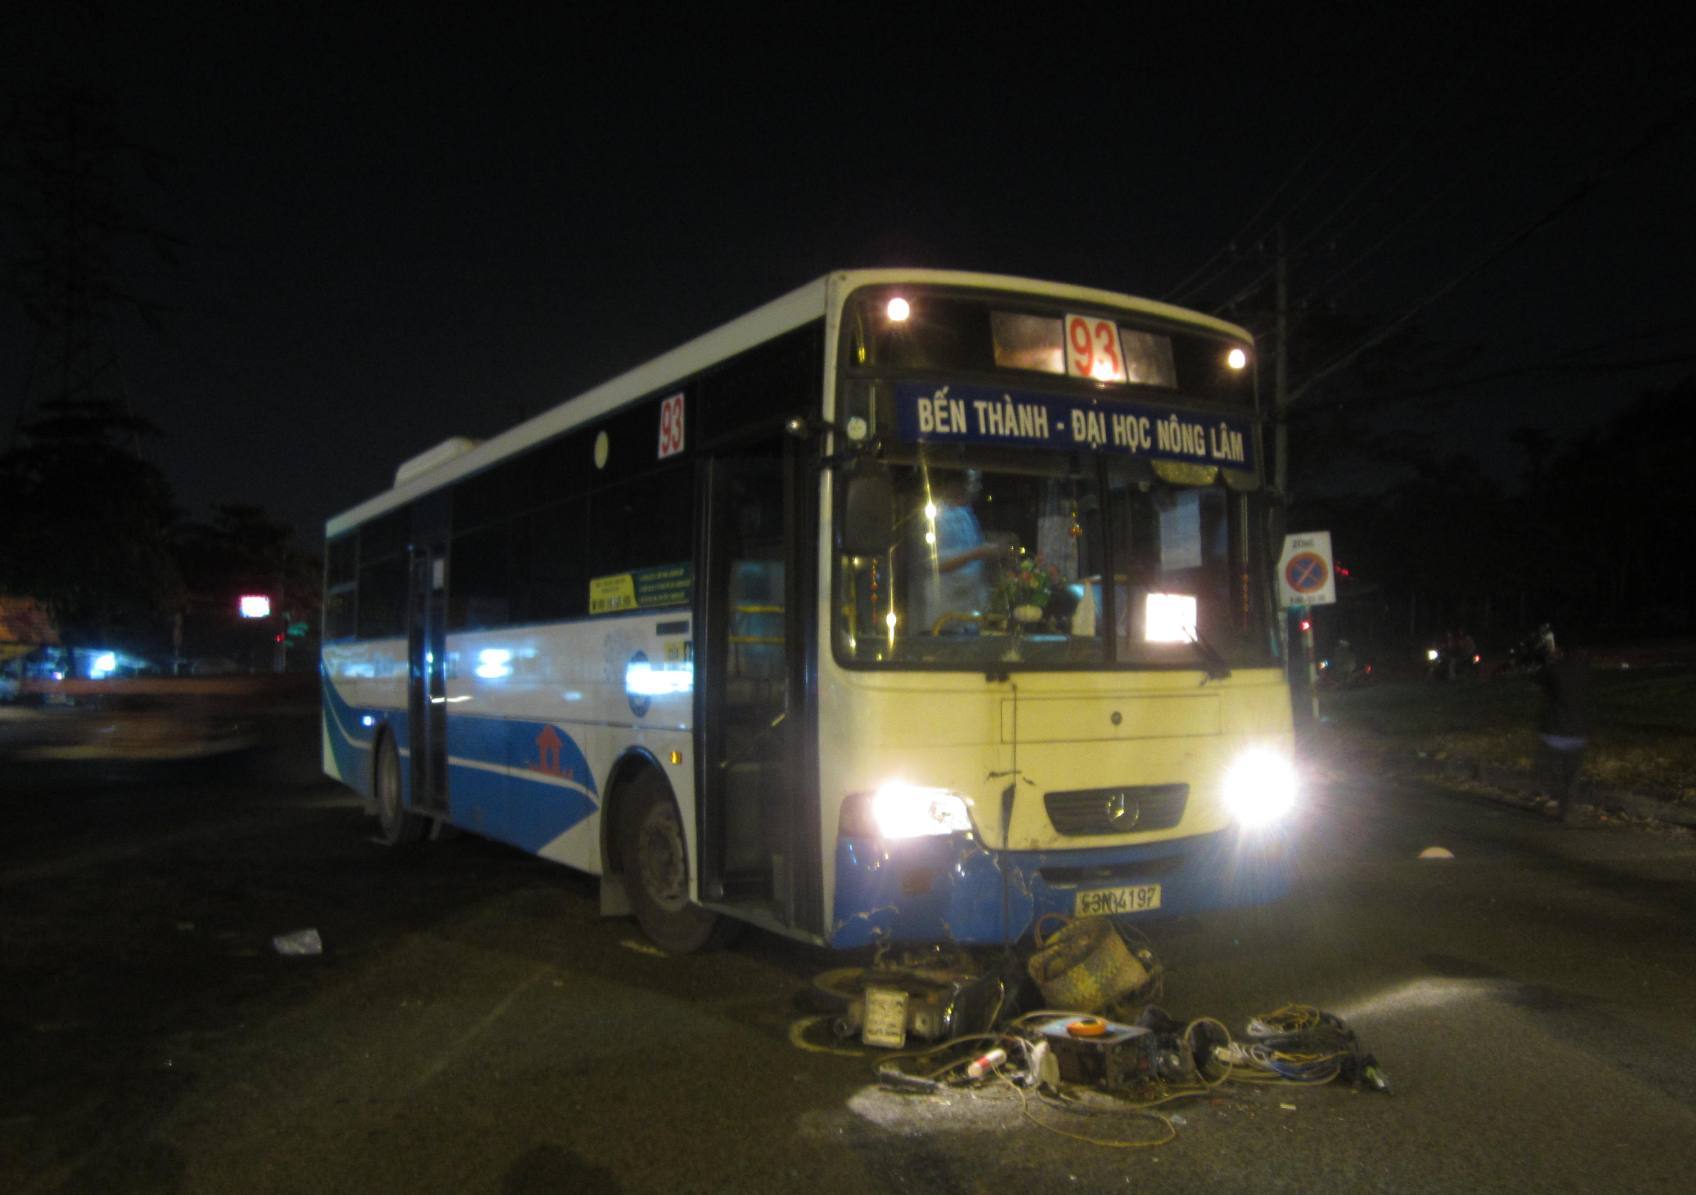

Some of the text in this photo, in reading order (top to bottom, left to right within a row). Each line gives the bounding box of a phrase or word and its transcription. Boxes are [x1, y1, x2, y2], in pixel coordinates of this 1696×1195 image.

[1069, 316, 1119, 384] 93
[661, 397, 683, 455] 93
[918, 386, 967, 434] BẾN
[974, 394, 1049, 440] THÀNH
[1071, 408, 1107, 449] ĐẠI
[1112, 413, 1152, 454] HỌC
[1157, 414, 1207, 457] NÔNG
[1211, 422, 1245, 463] LÂM
